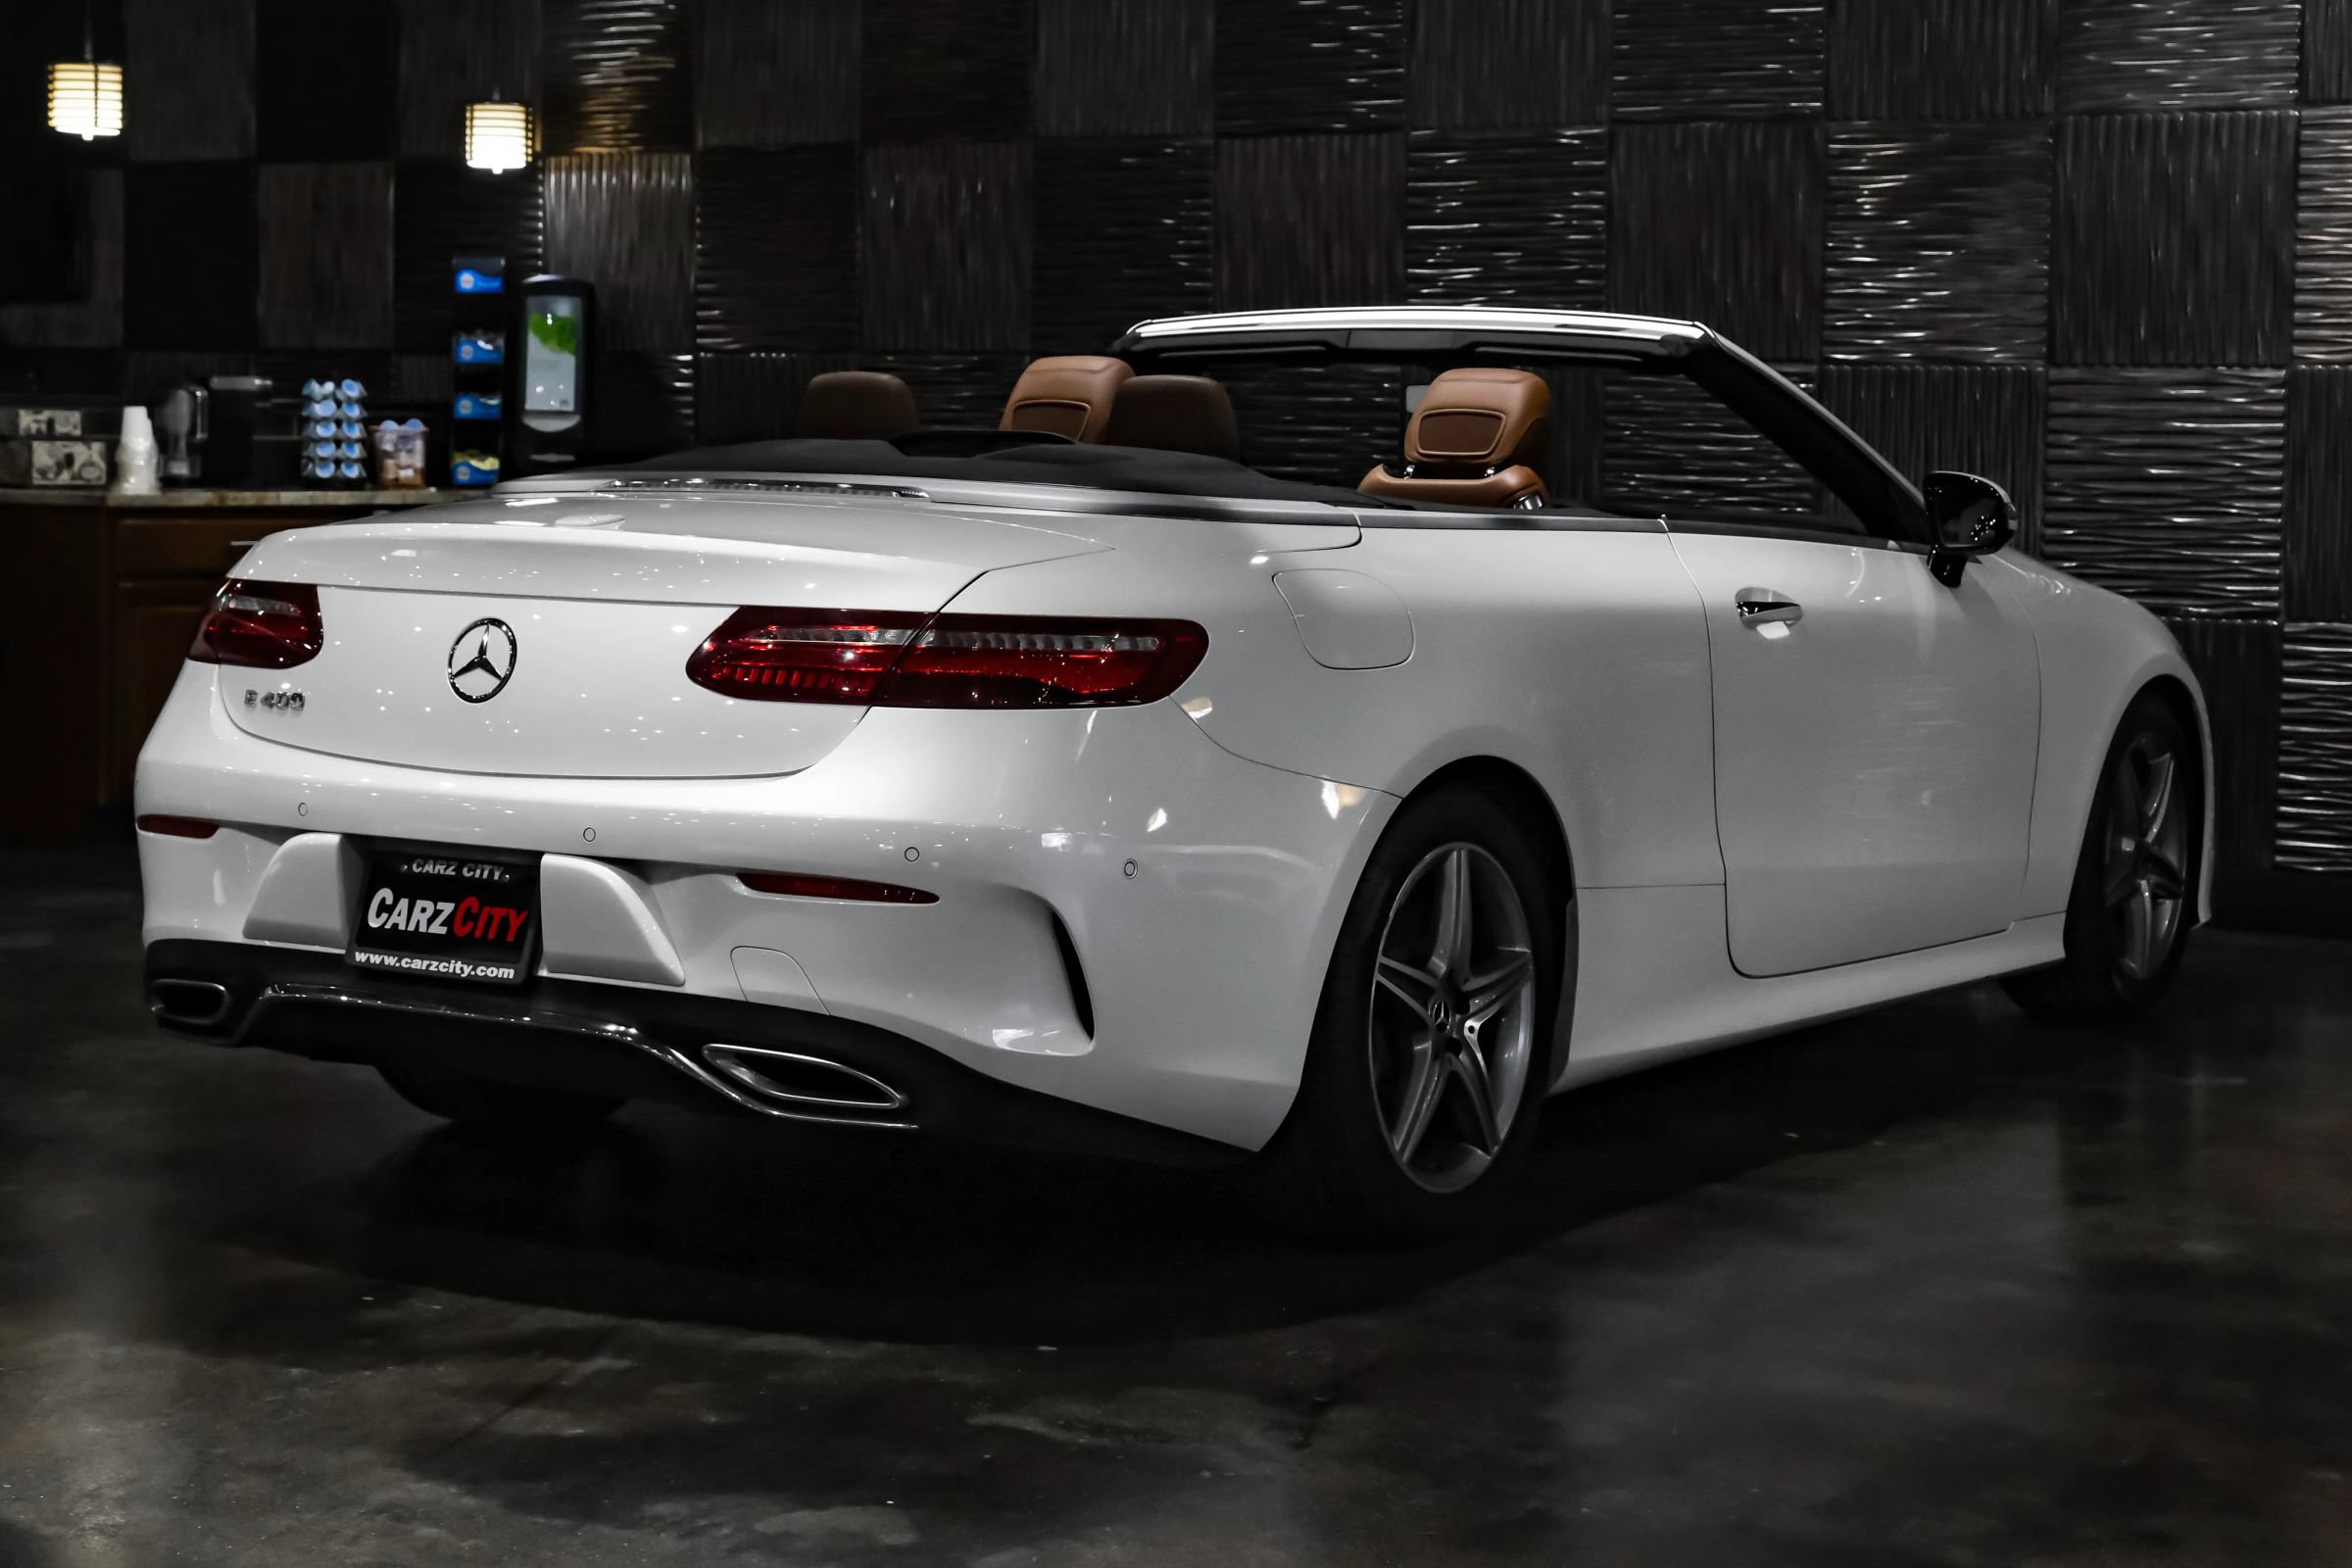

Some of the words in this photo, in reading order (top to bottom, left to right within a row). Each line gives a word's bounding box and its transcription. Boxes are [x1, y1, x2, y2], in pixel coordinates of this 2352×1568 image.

[244, 689, 259, 707] E
[412, 858, 457, 876] CARZ
[462, 861, 506, 881] CITY
[355, 951, 515, 980] www.carzcity.com
